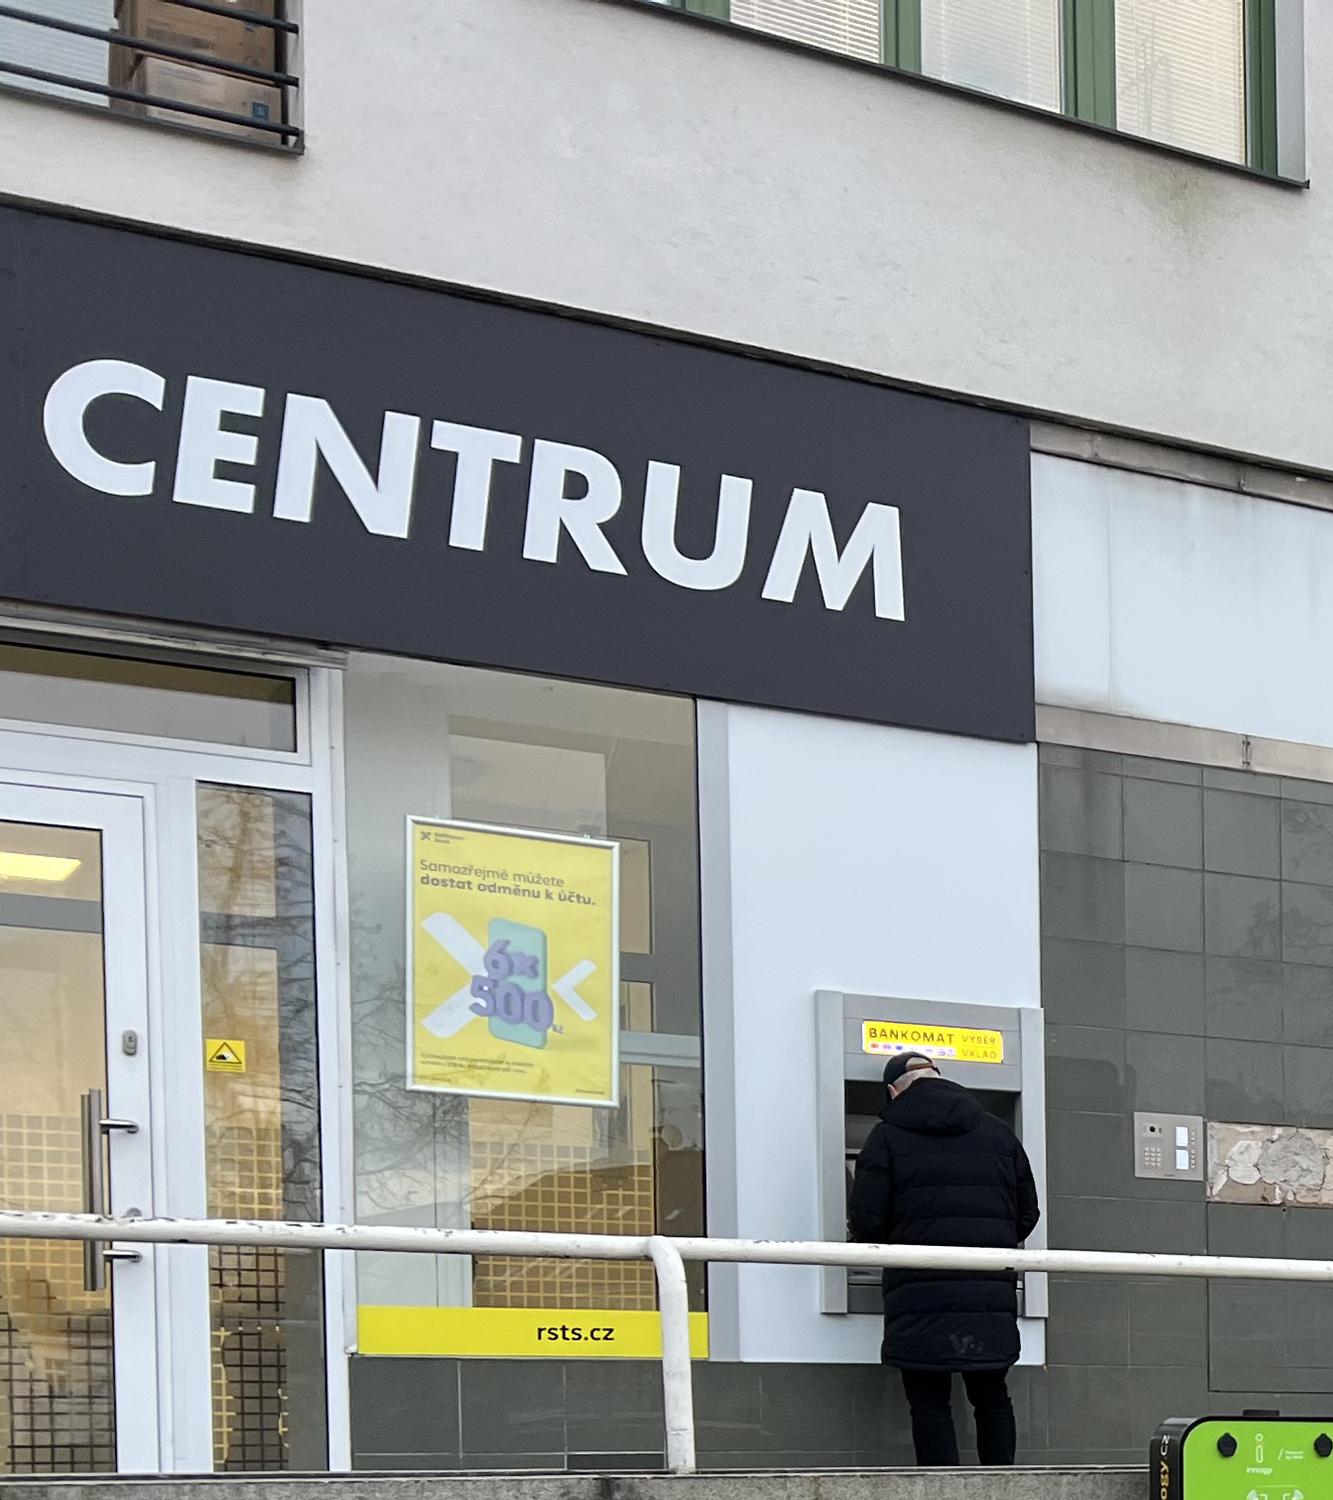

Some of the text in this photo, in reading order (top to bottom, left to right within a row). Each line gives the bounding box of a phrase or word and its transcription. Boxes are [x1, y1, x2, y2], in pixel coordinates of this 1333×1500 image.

[43, 358, 906, 622] CENTRUM
[420, 859, 565, 888] Samozřejmě můžete
[420, 874, 596, 906] dostat odměnu k účtu.
[469, 974, 555, 1032] 500
[869, 1027, 955, 1044] BANKOMAT
[962, 1049, 998, 1060] VKLAD
[537, 1324, 615, 1341] rsts.cz
